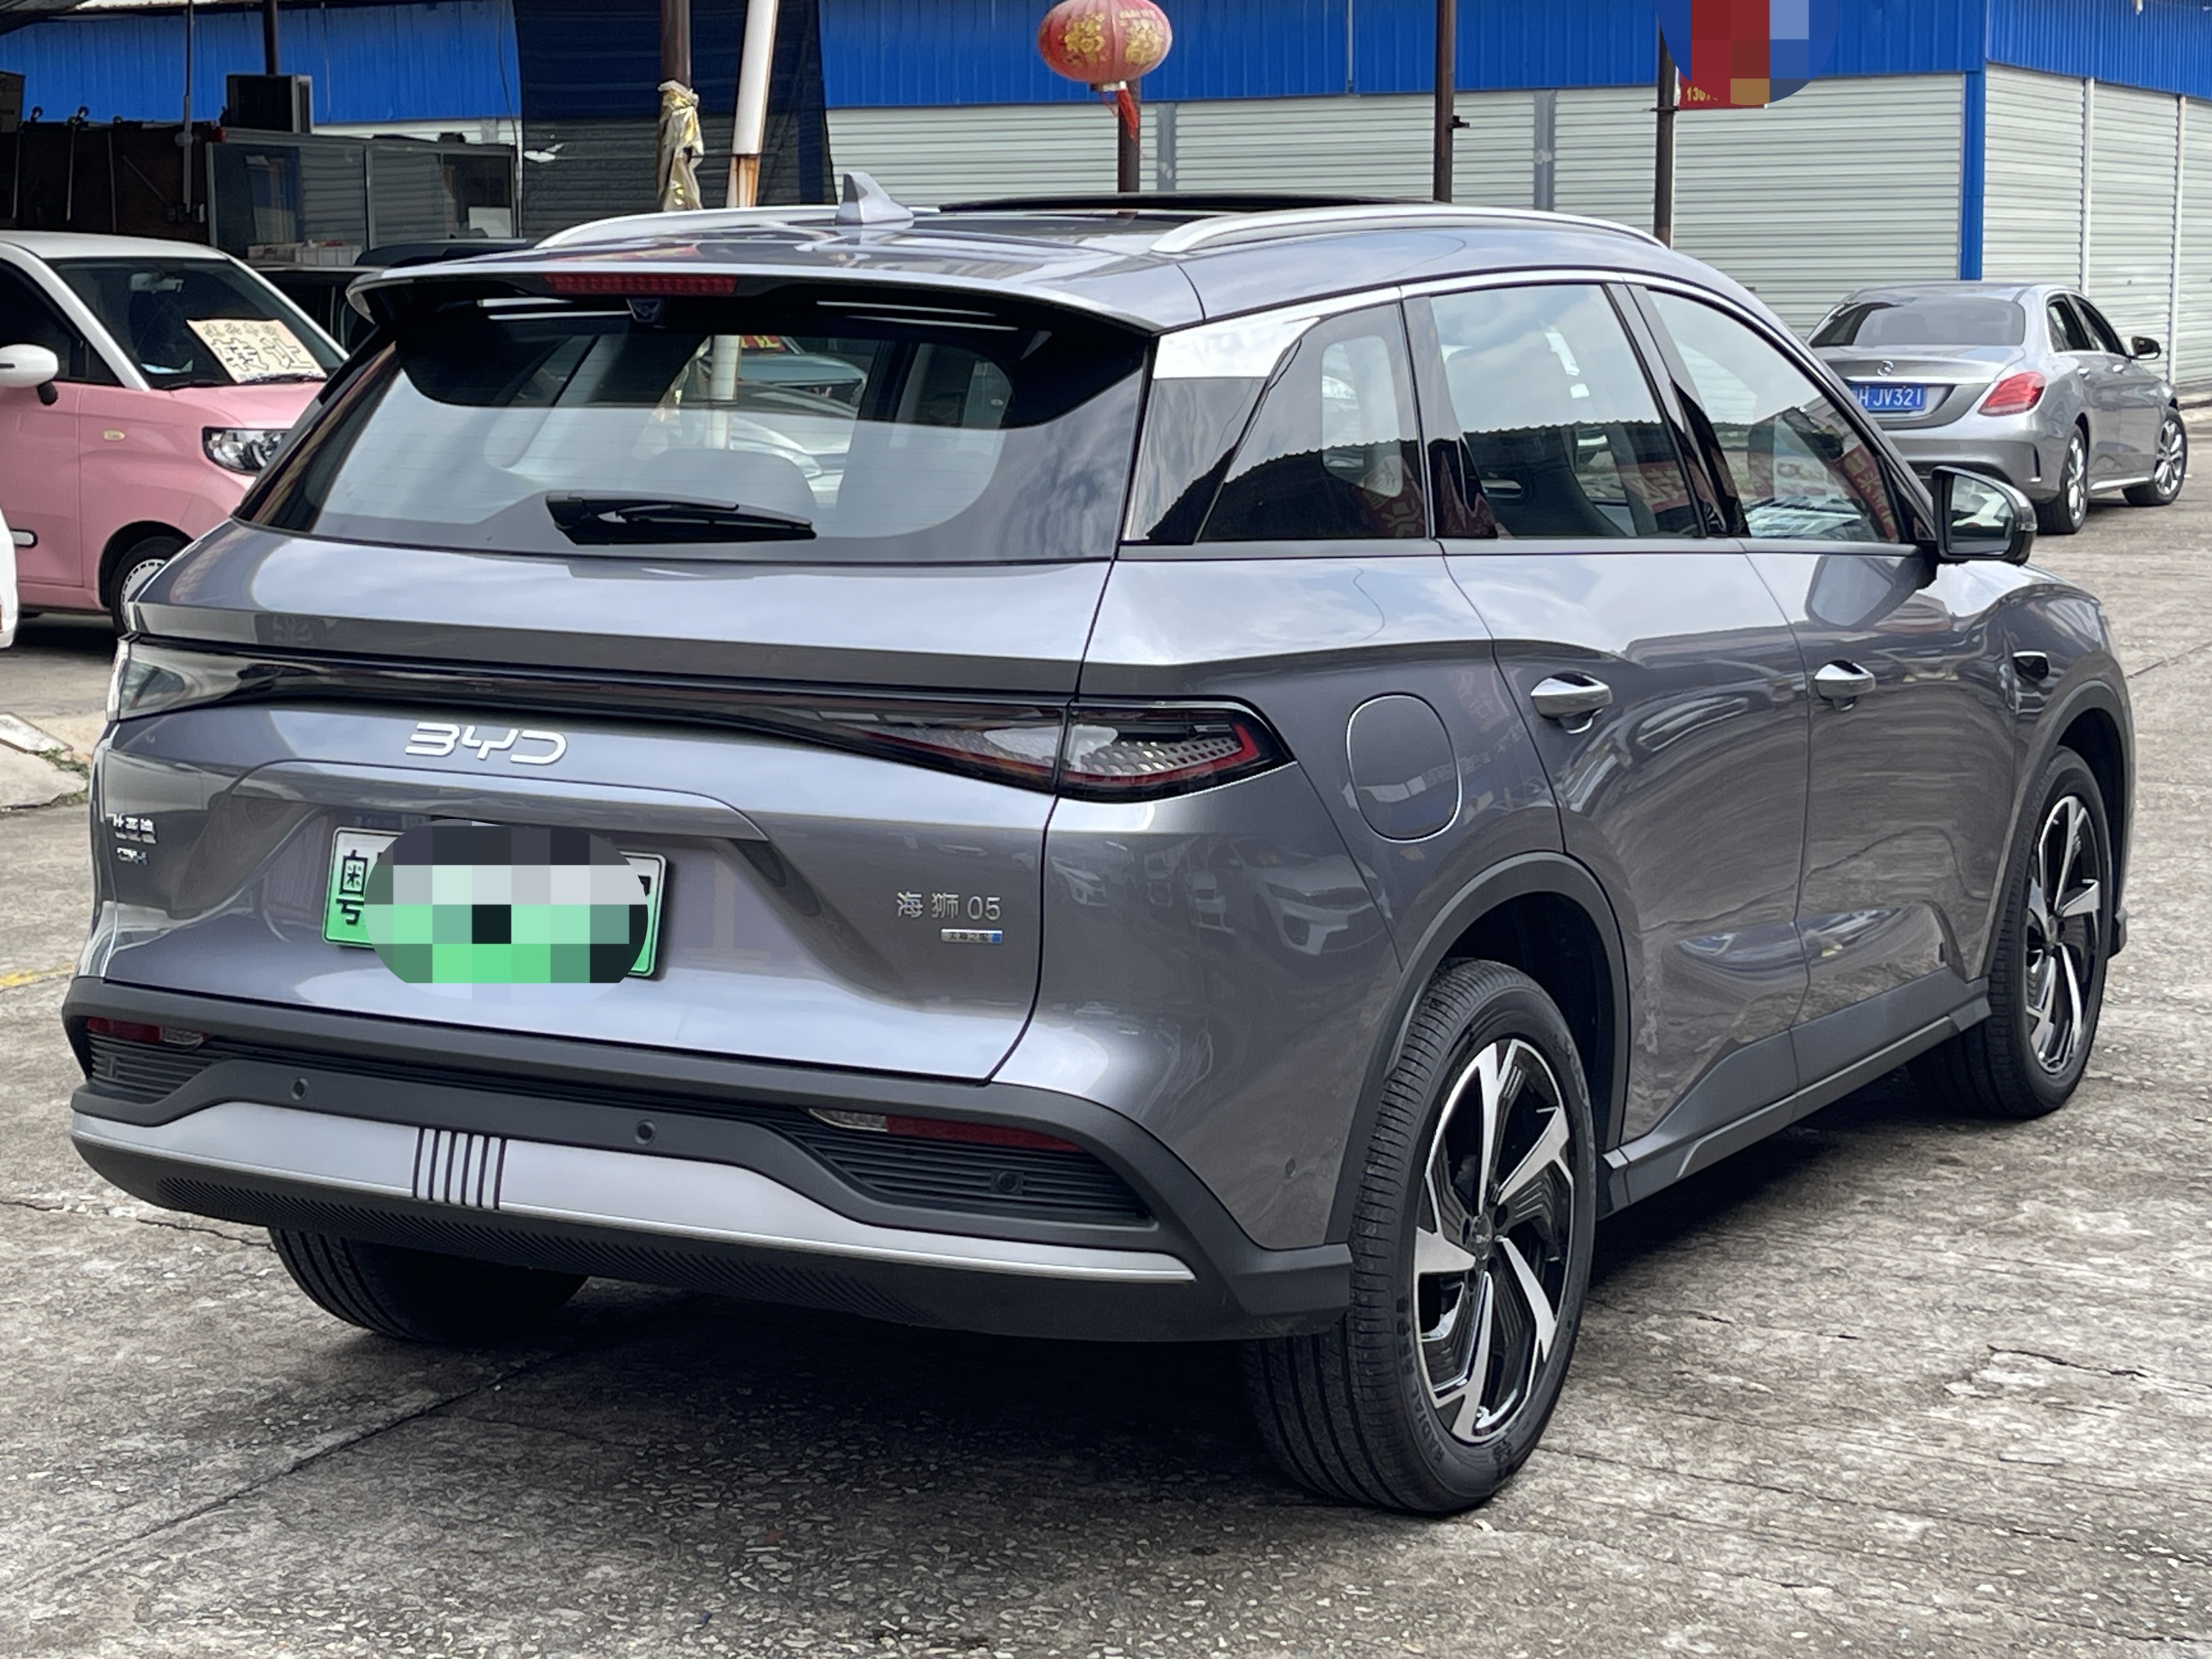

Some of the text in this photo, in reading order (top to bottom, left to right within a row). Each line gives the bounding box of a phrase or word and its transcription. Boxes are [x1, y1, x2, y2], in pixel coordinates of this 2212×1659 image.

[405, 722, 567, 766] BYD
[897, 891, 1001, 921] 海狮 05
